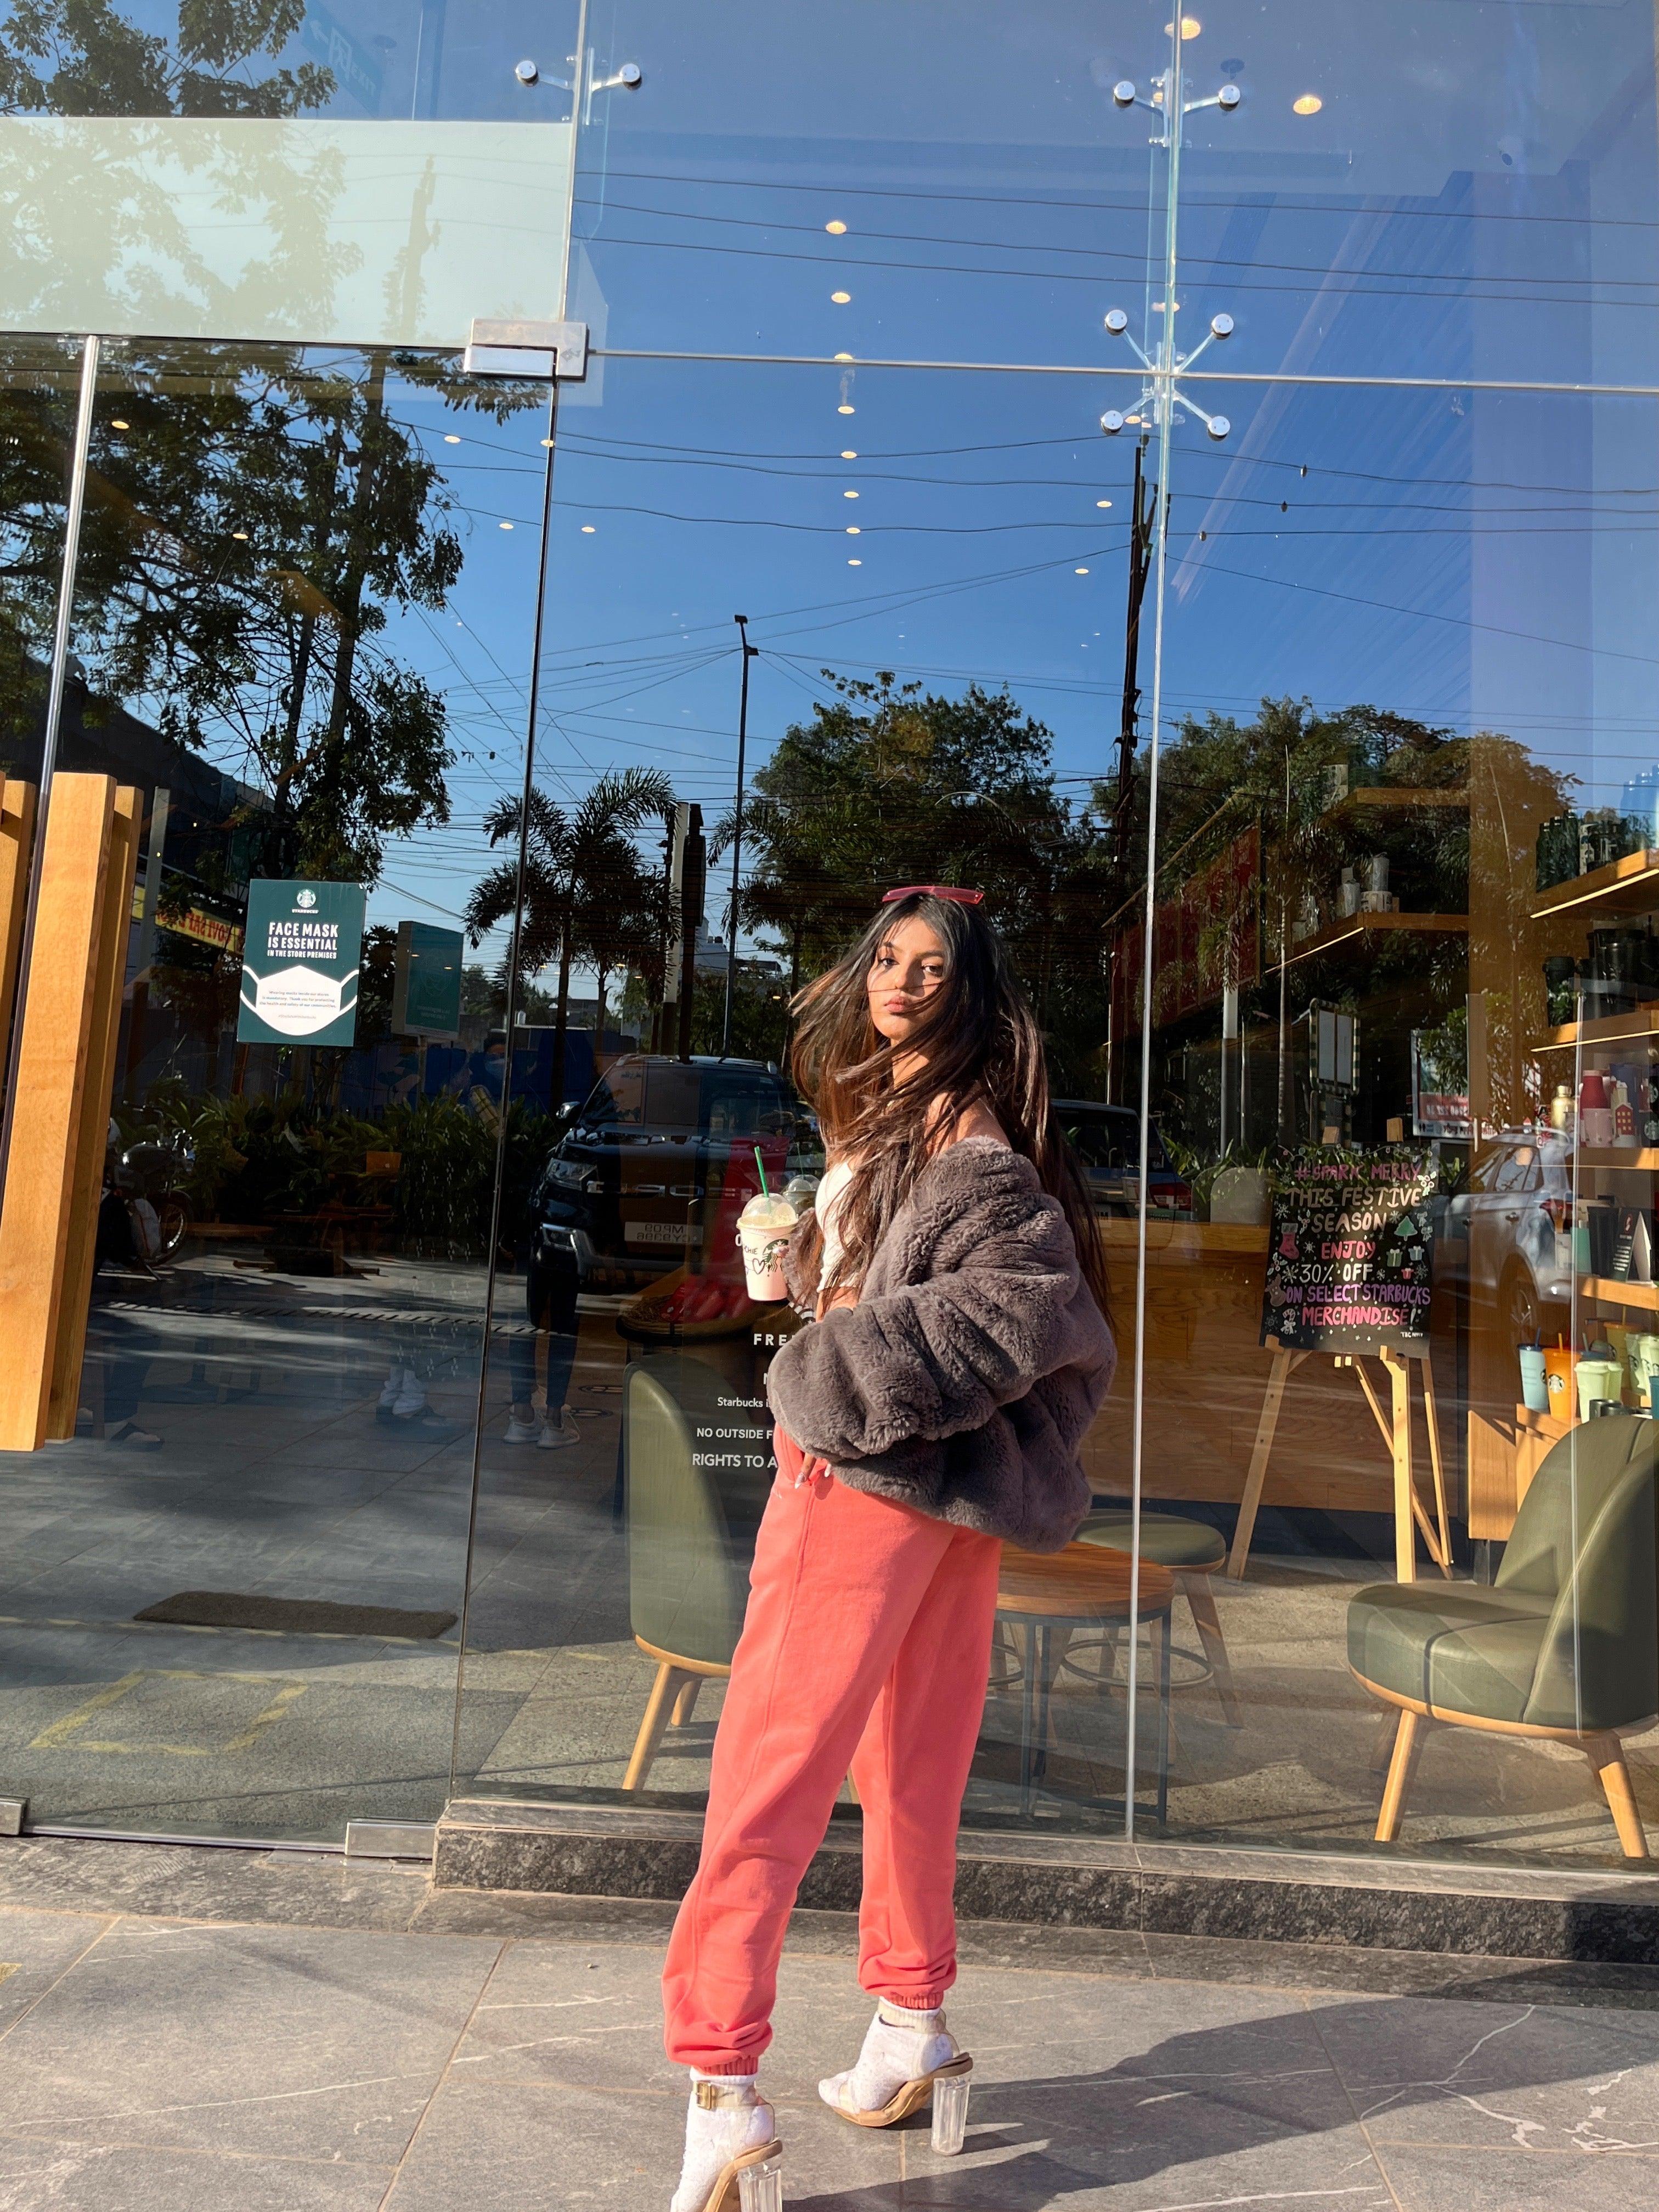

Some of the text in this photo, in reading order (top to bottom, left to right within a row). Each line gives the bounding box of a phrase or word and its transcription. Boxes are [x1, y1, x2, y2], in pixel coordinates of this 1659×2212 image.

[269, 922, 338, 938] FACE MASK
[268, 936, 337, 950] IS ESSENTIAL
[1295, 1161, 1422, 1181] #SPARK MERRY
[1284, 1187, 1421, 1207] THIS FESTIVE
[1311, 1212, 1387, 1233] SEASON
[1322, 1240, 1376, 1260] ENJOY
[1299, 1263, 1373, 1284] 30% OFF
[1286, 1284, 1431, 1305] ON SELECT STARBUCKS
[1302, 1306, 1417, 1331] MERCHANDISE!
[754, 1334, 797, 1346] FRE
[717, 1397, 763, 1408] Starbucks
[697, 1428, 713, 1437] NO
[715, 1428, 764, 1439] OUTSIDE
[692, 1454, 741, 1467] RIGHTS
[744, 1455, 764, 1468] TO
